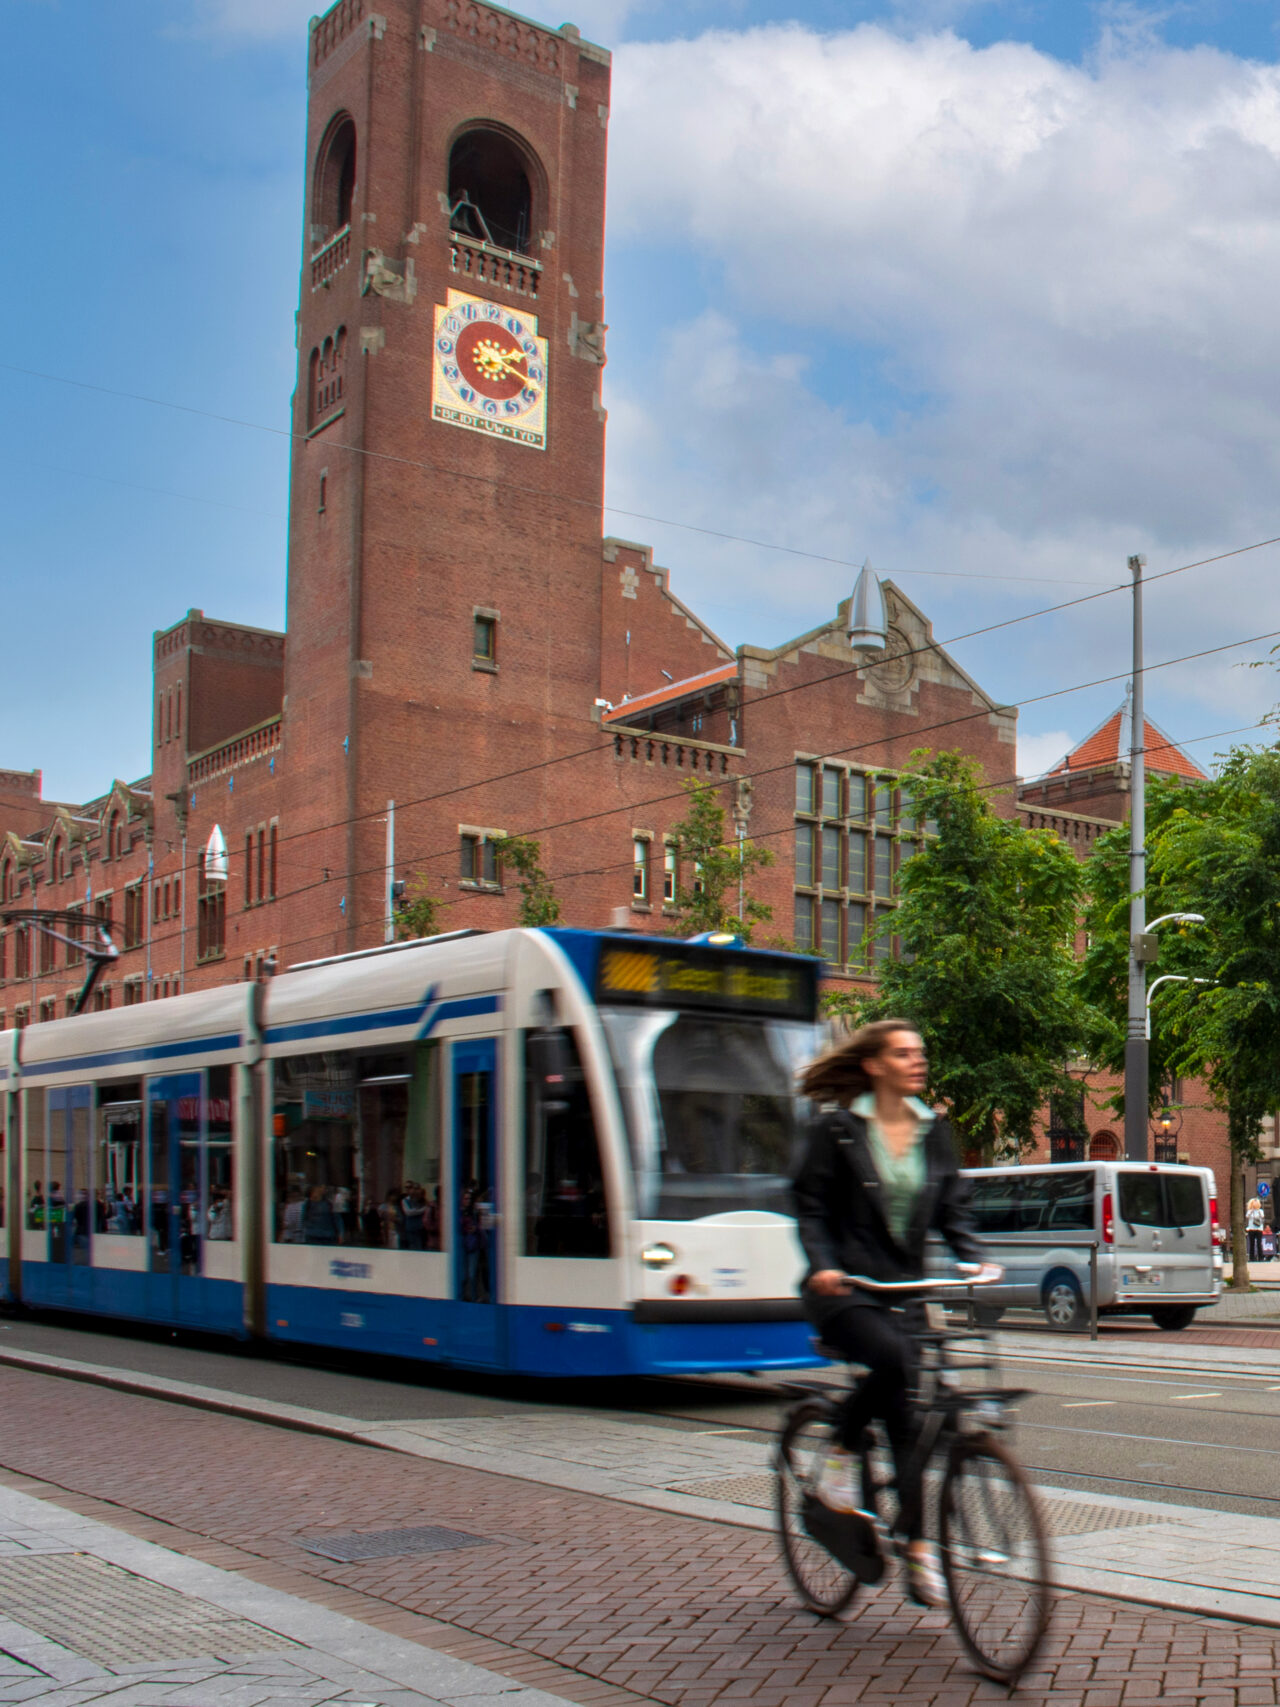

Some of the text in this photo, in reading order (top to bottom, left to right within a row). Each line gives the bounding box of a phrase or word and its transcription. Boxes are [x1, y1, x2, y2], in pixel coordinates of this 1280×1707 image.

[487, 305, 500, 319] 12
[446, 366, 457, 380] 8
[485, 420, 505, 434] UW
[511, 428, 537, 443] TYD
